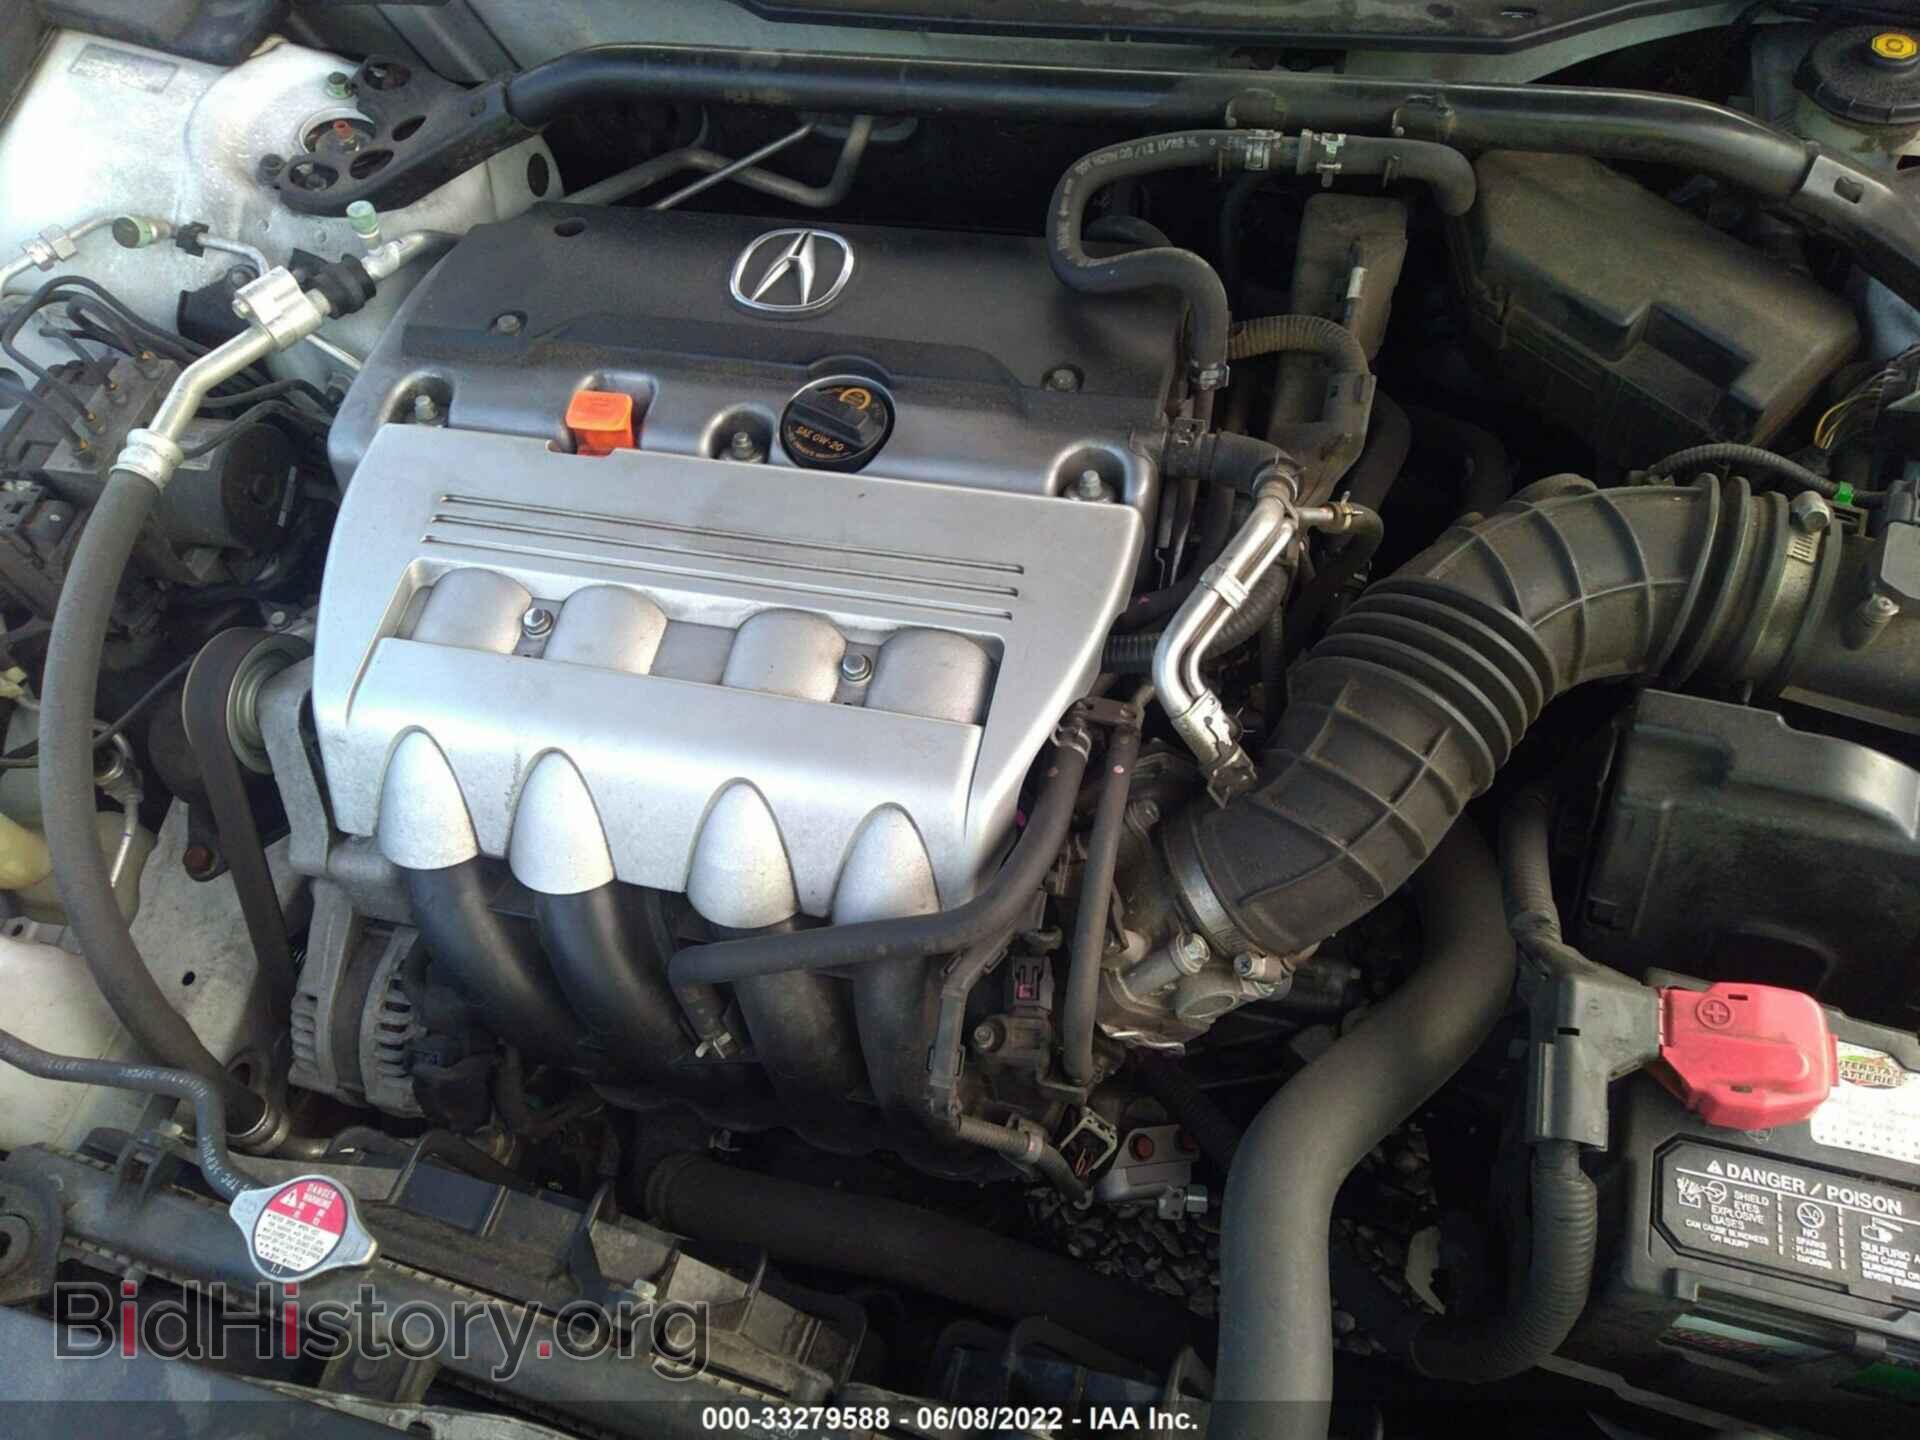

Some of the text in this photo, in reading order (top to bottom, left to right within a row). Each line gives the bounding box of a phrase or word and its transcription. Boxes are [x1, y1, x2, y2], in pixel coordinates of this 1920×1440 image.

[795, 425, 813, 439] SAE
[1840, 1070, 1903, 1087] ATTERIES
[1726, 1163, 1806, 1194] DANGER
[1827, 1185, 1903, 1216] POISON
[1733, 1190, 1770, 1206] SHIELD
[1711, 1205, 1765, 1224] EXPLOSIVE
[1733, 1201, 1761, 1214] EYES
[1710, 1214, 1745, 1230] GASES
[1802, 1227, 1819, 1239] NO
[1860, 1241, 1911, 1262] SULFURIC
